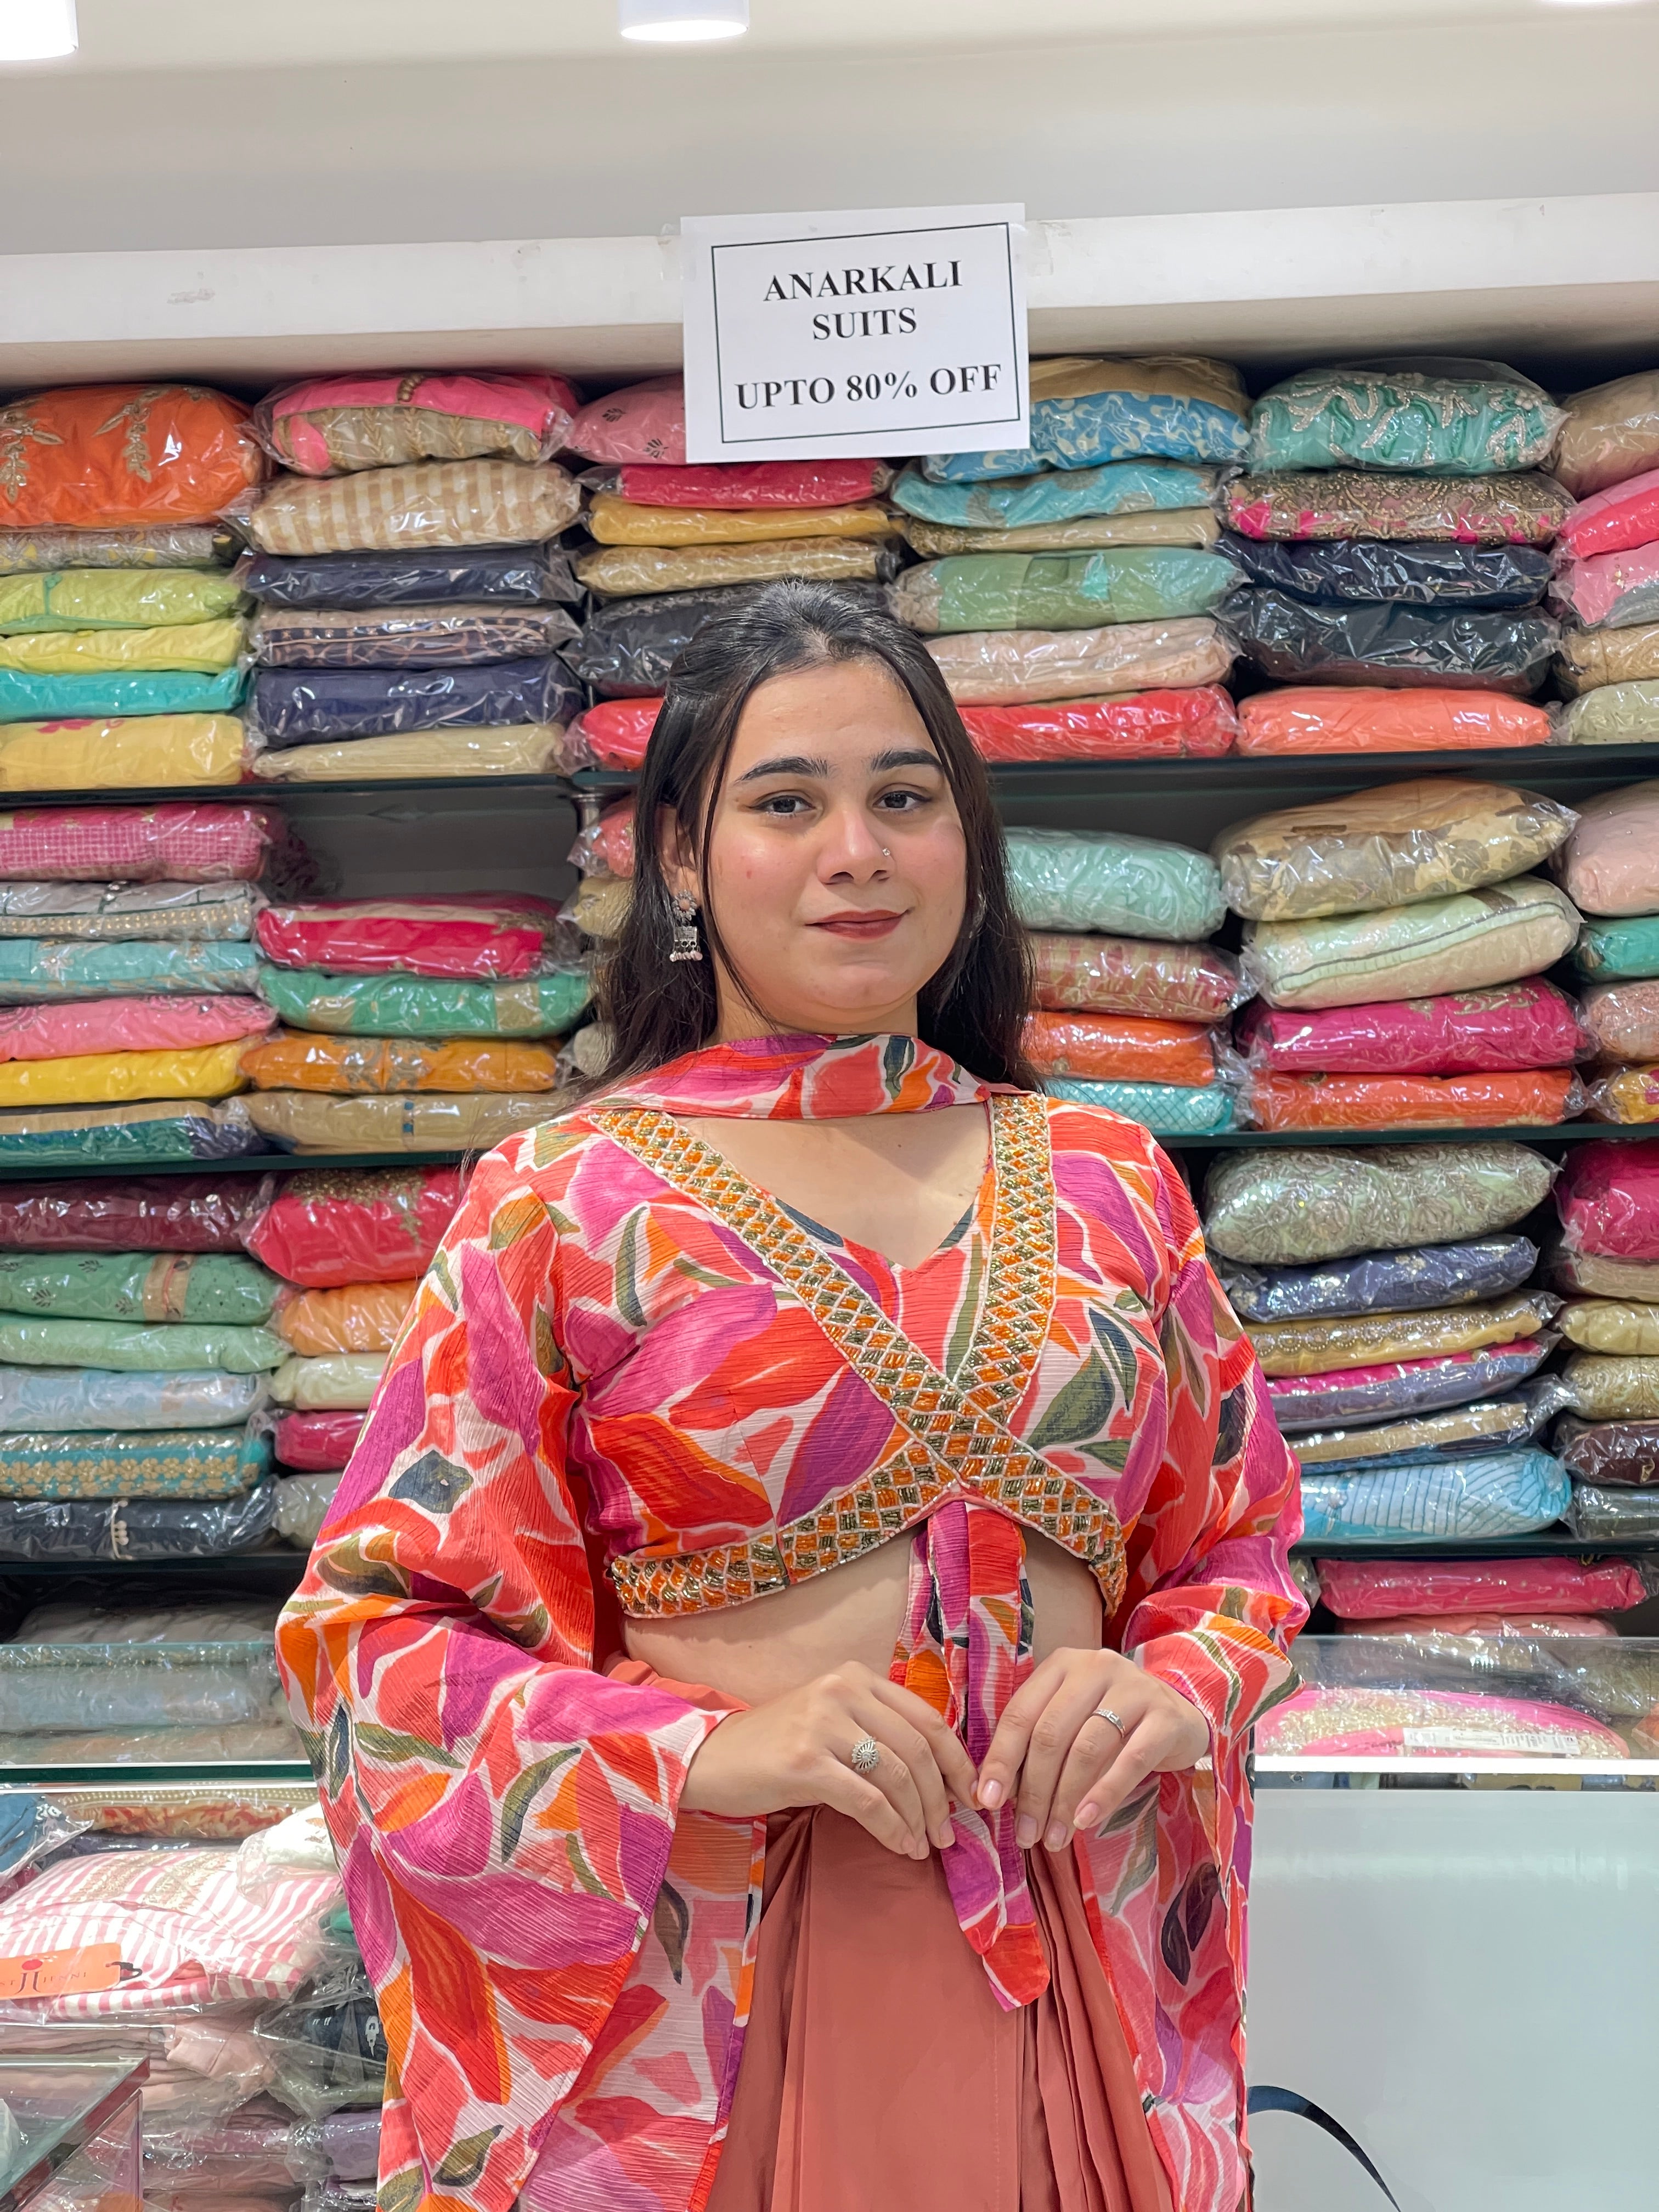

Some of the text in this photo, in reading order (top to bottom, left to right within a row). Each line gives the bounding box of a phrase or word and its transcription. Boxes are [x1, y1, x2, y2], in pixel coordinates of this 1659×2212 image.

[763, 261, 963, 302] ANARKALI
[812, 307, 917, 340] SUITS
[735, 364, 1002, 410] UPTO 80% OFF
